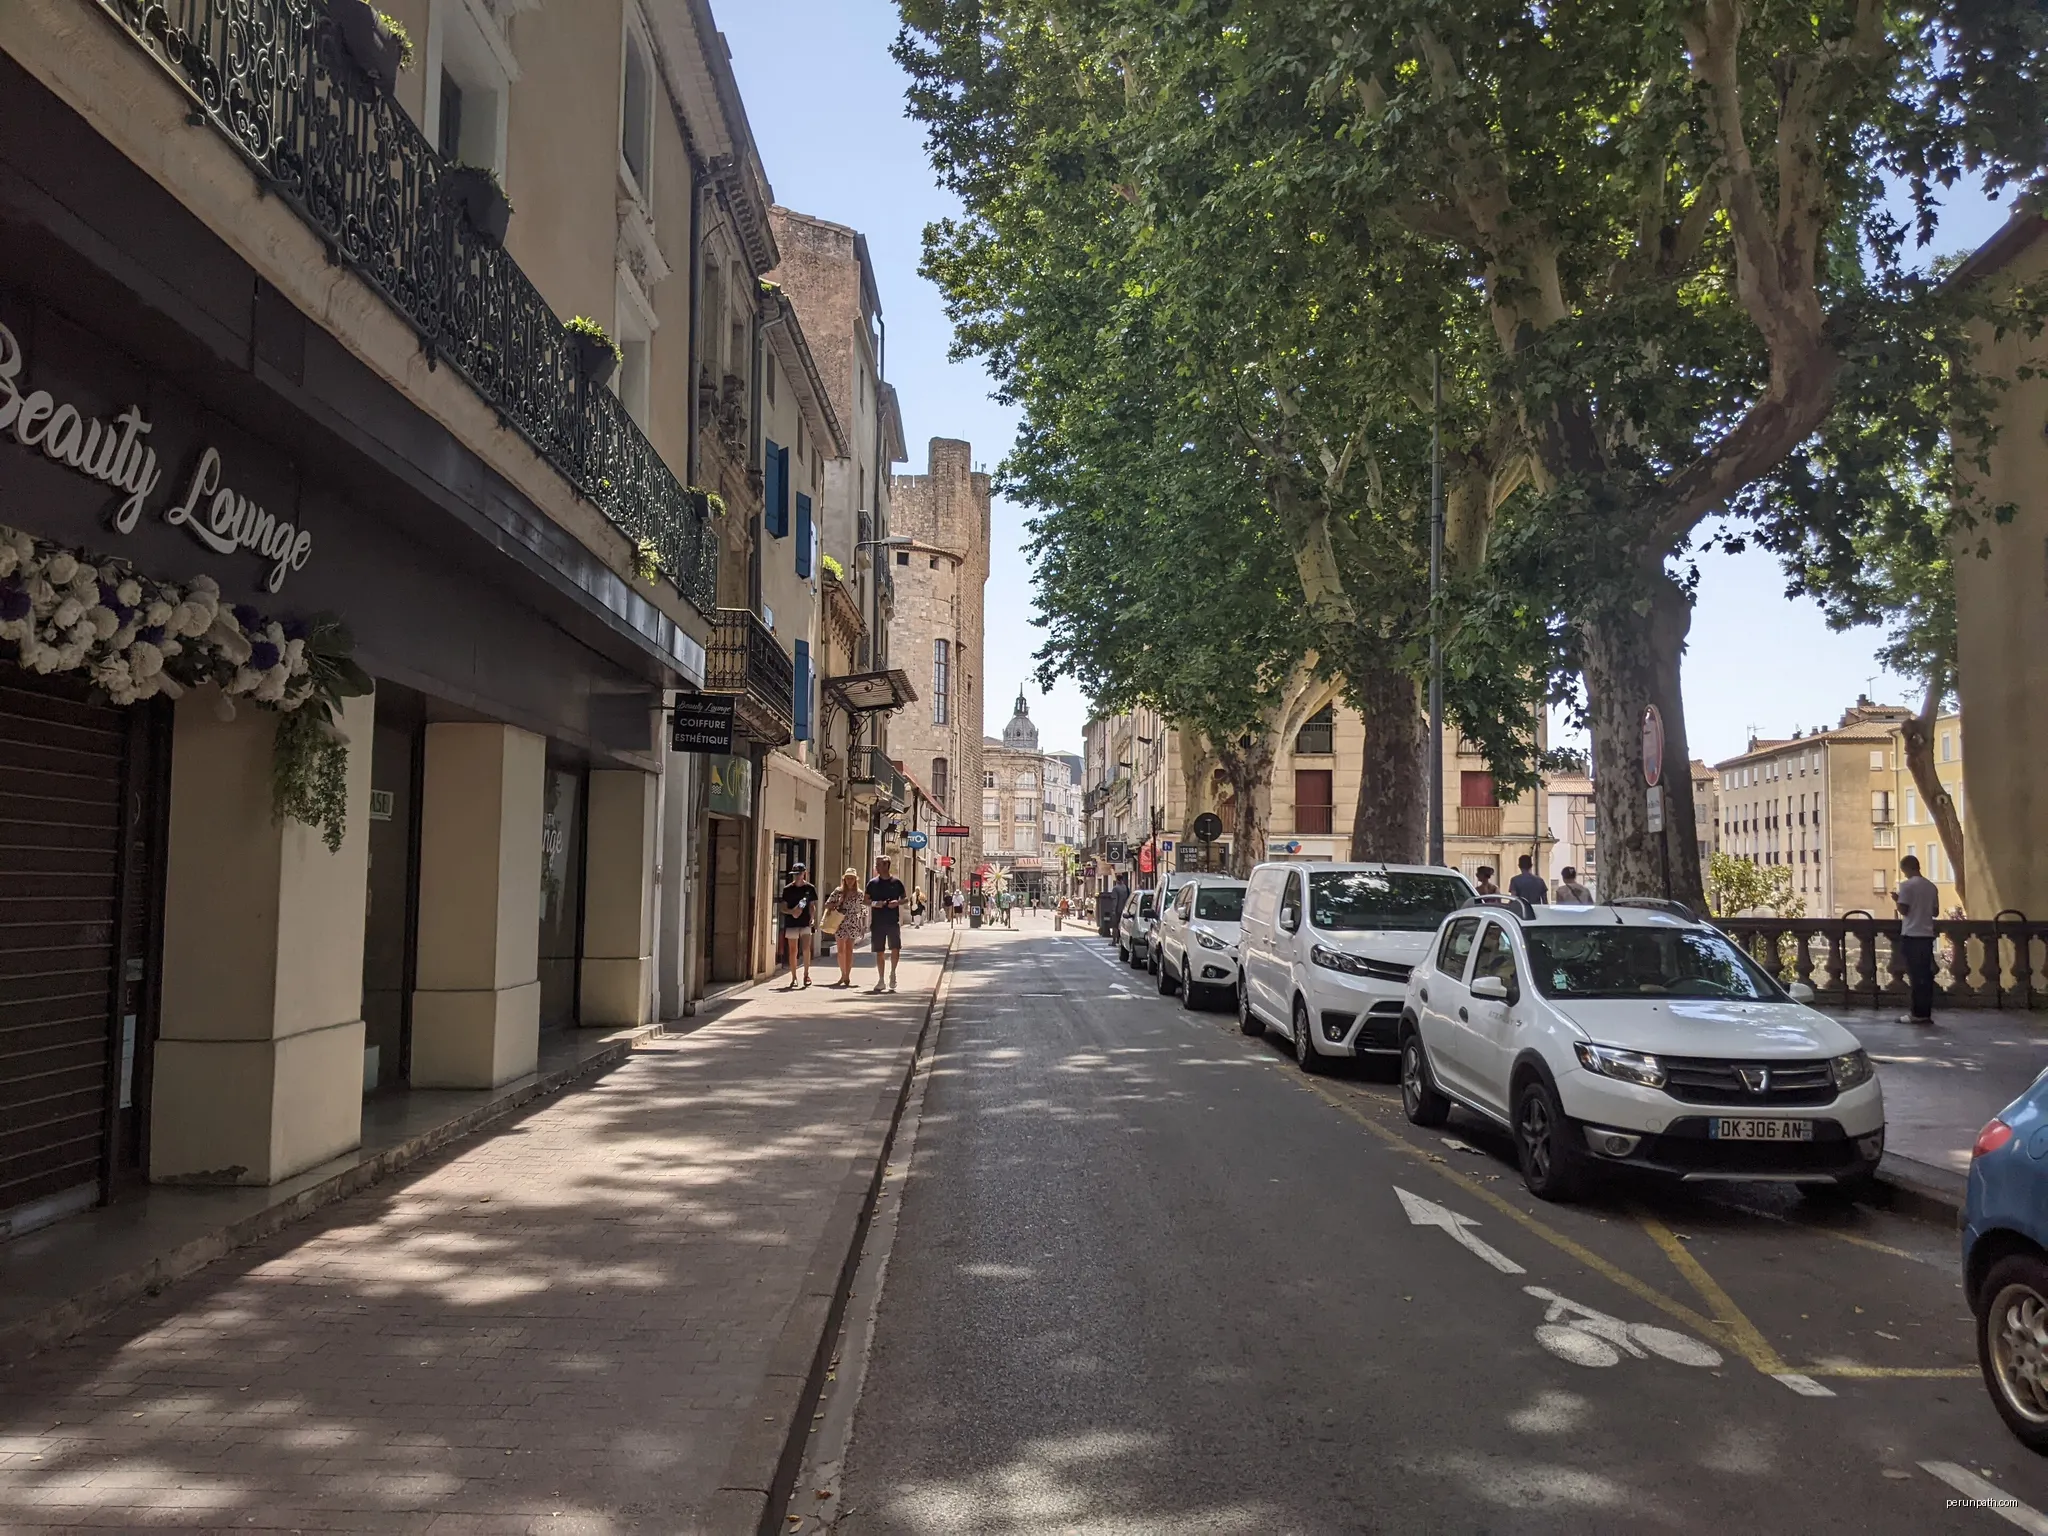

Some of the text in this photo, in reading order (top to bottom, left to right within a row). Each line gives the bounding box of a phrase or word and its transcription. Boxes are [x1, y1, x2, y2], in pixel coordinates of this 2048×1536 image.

[167, 447, 311, 593] Lounge
[680, 718, 726, 729] COIFFURE
[675, 733, 729, 745] ESTHÉTIQUE
[1721, 1121, 1801, 1138] DK-306-AN
